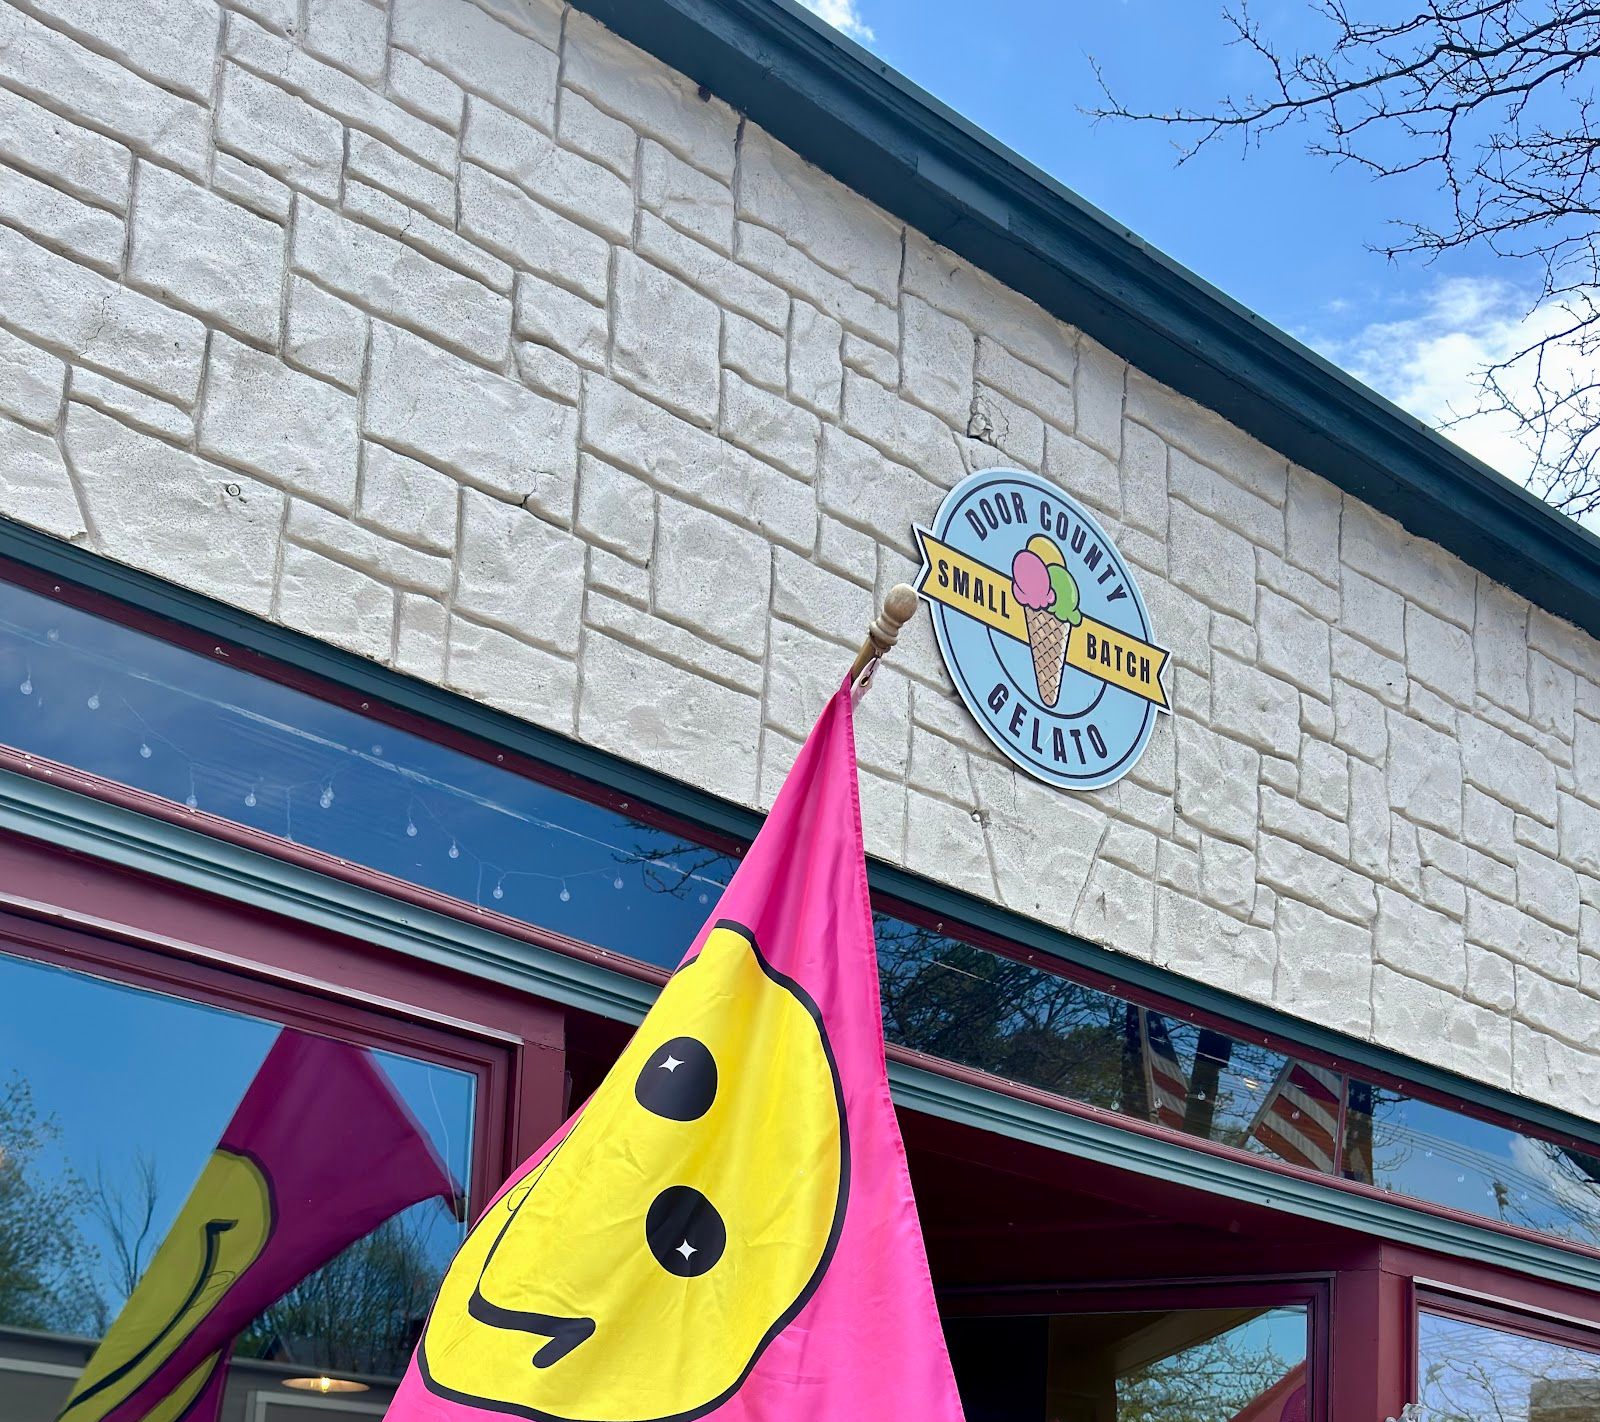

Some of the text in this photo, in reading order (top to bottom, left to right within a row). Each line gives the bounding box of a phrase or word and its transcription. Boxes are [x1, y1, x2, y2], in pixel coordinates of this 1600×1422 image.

[965, 491, 1128, 603] DOOR COUNTY
[937, 559, 1151, 684] SMALL BATCH
[987, 683, 1108, 764] GELATO
